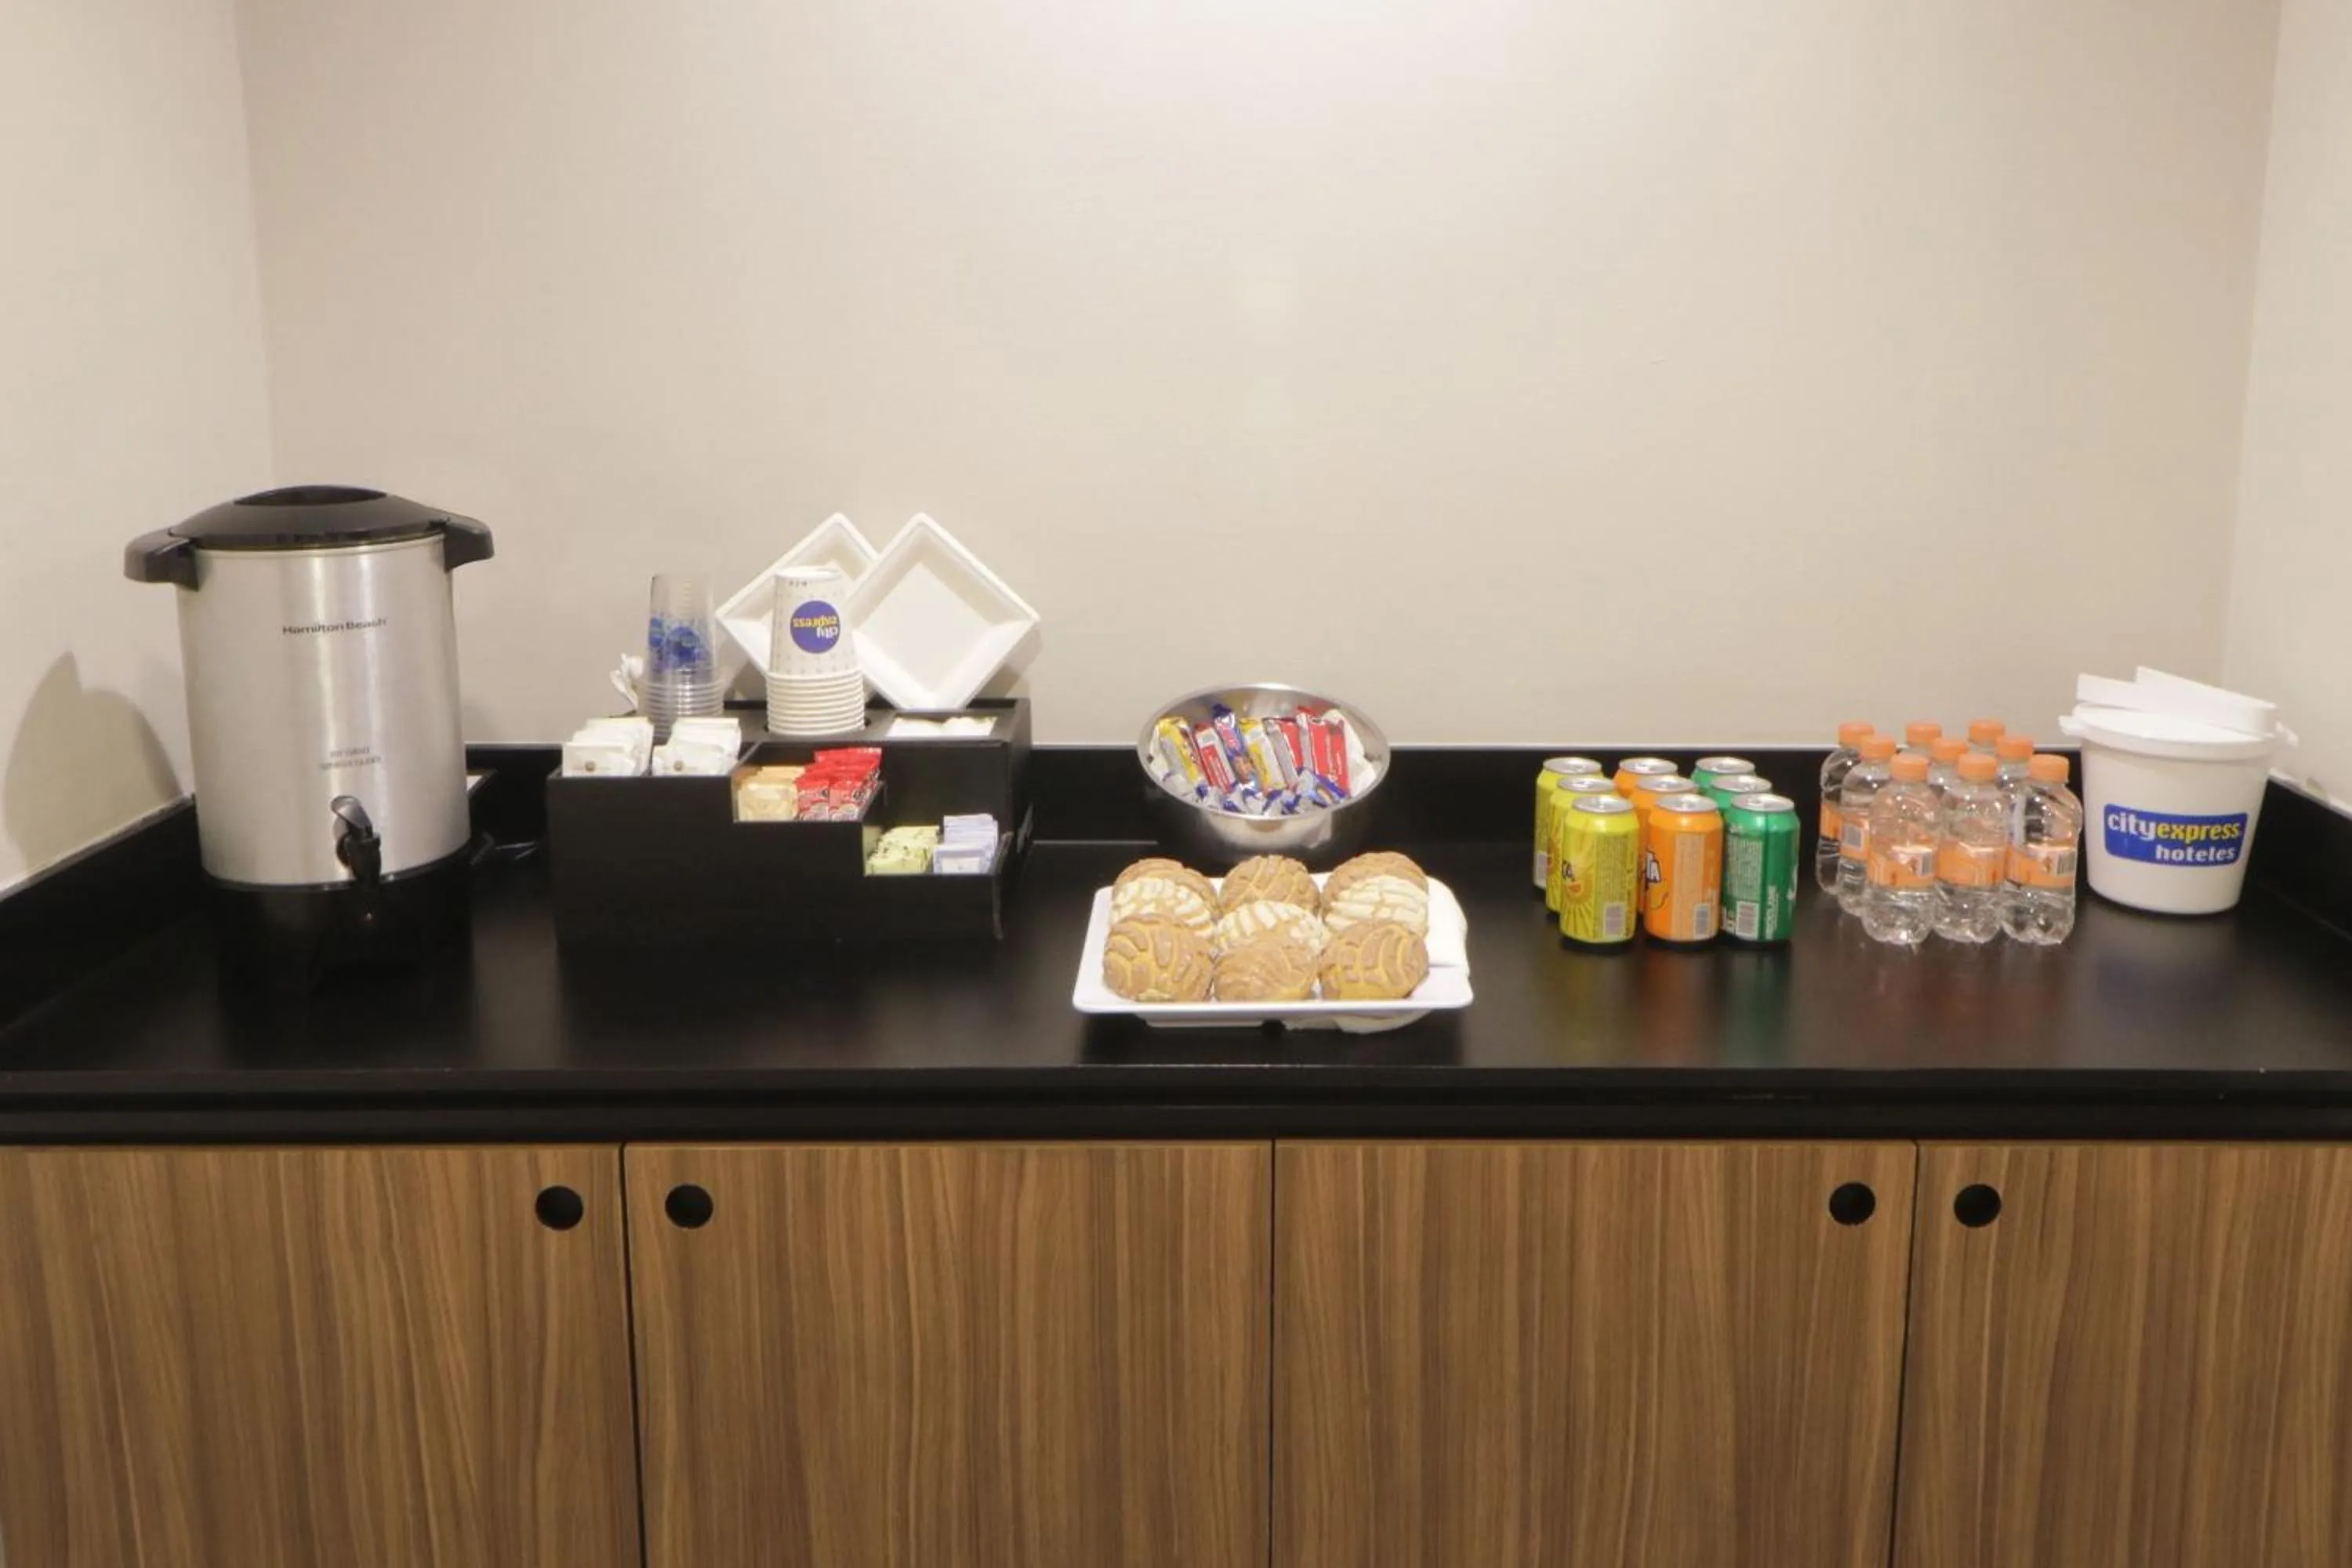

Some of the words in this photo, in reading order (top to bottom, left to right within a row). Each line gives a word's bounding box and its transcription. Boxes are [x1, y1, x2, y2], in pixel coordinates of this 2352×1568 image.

[793, 615, 837, 628] express
[282, 623, 344, 634] Hamilton
[816, 626, 838, 639] city
[2156, 844, 2236, 862] hoteles
